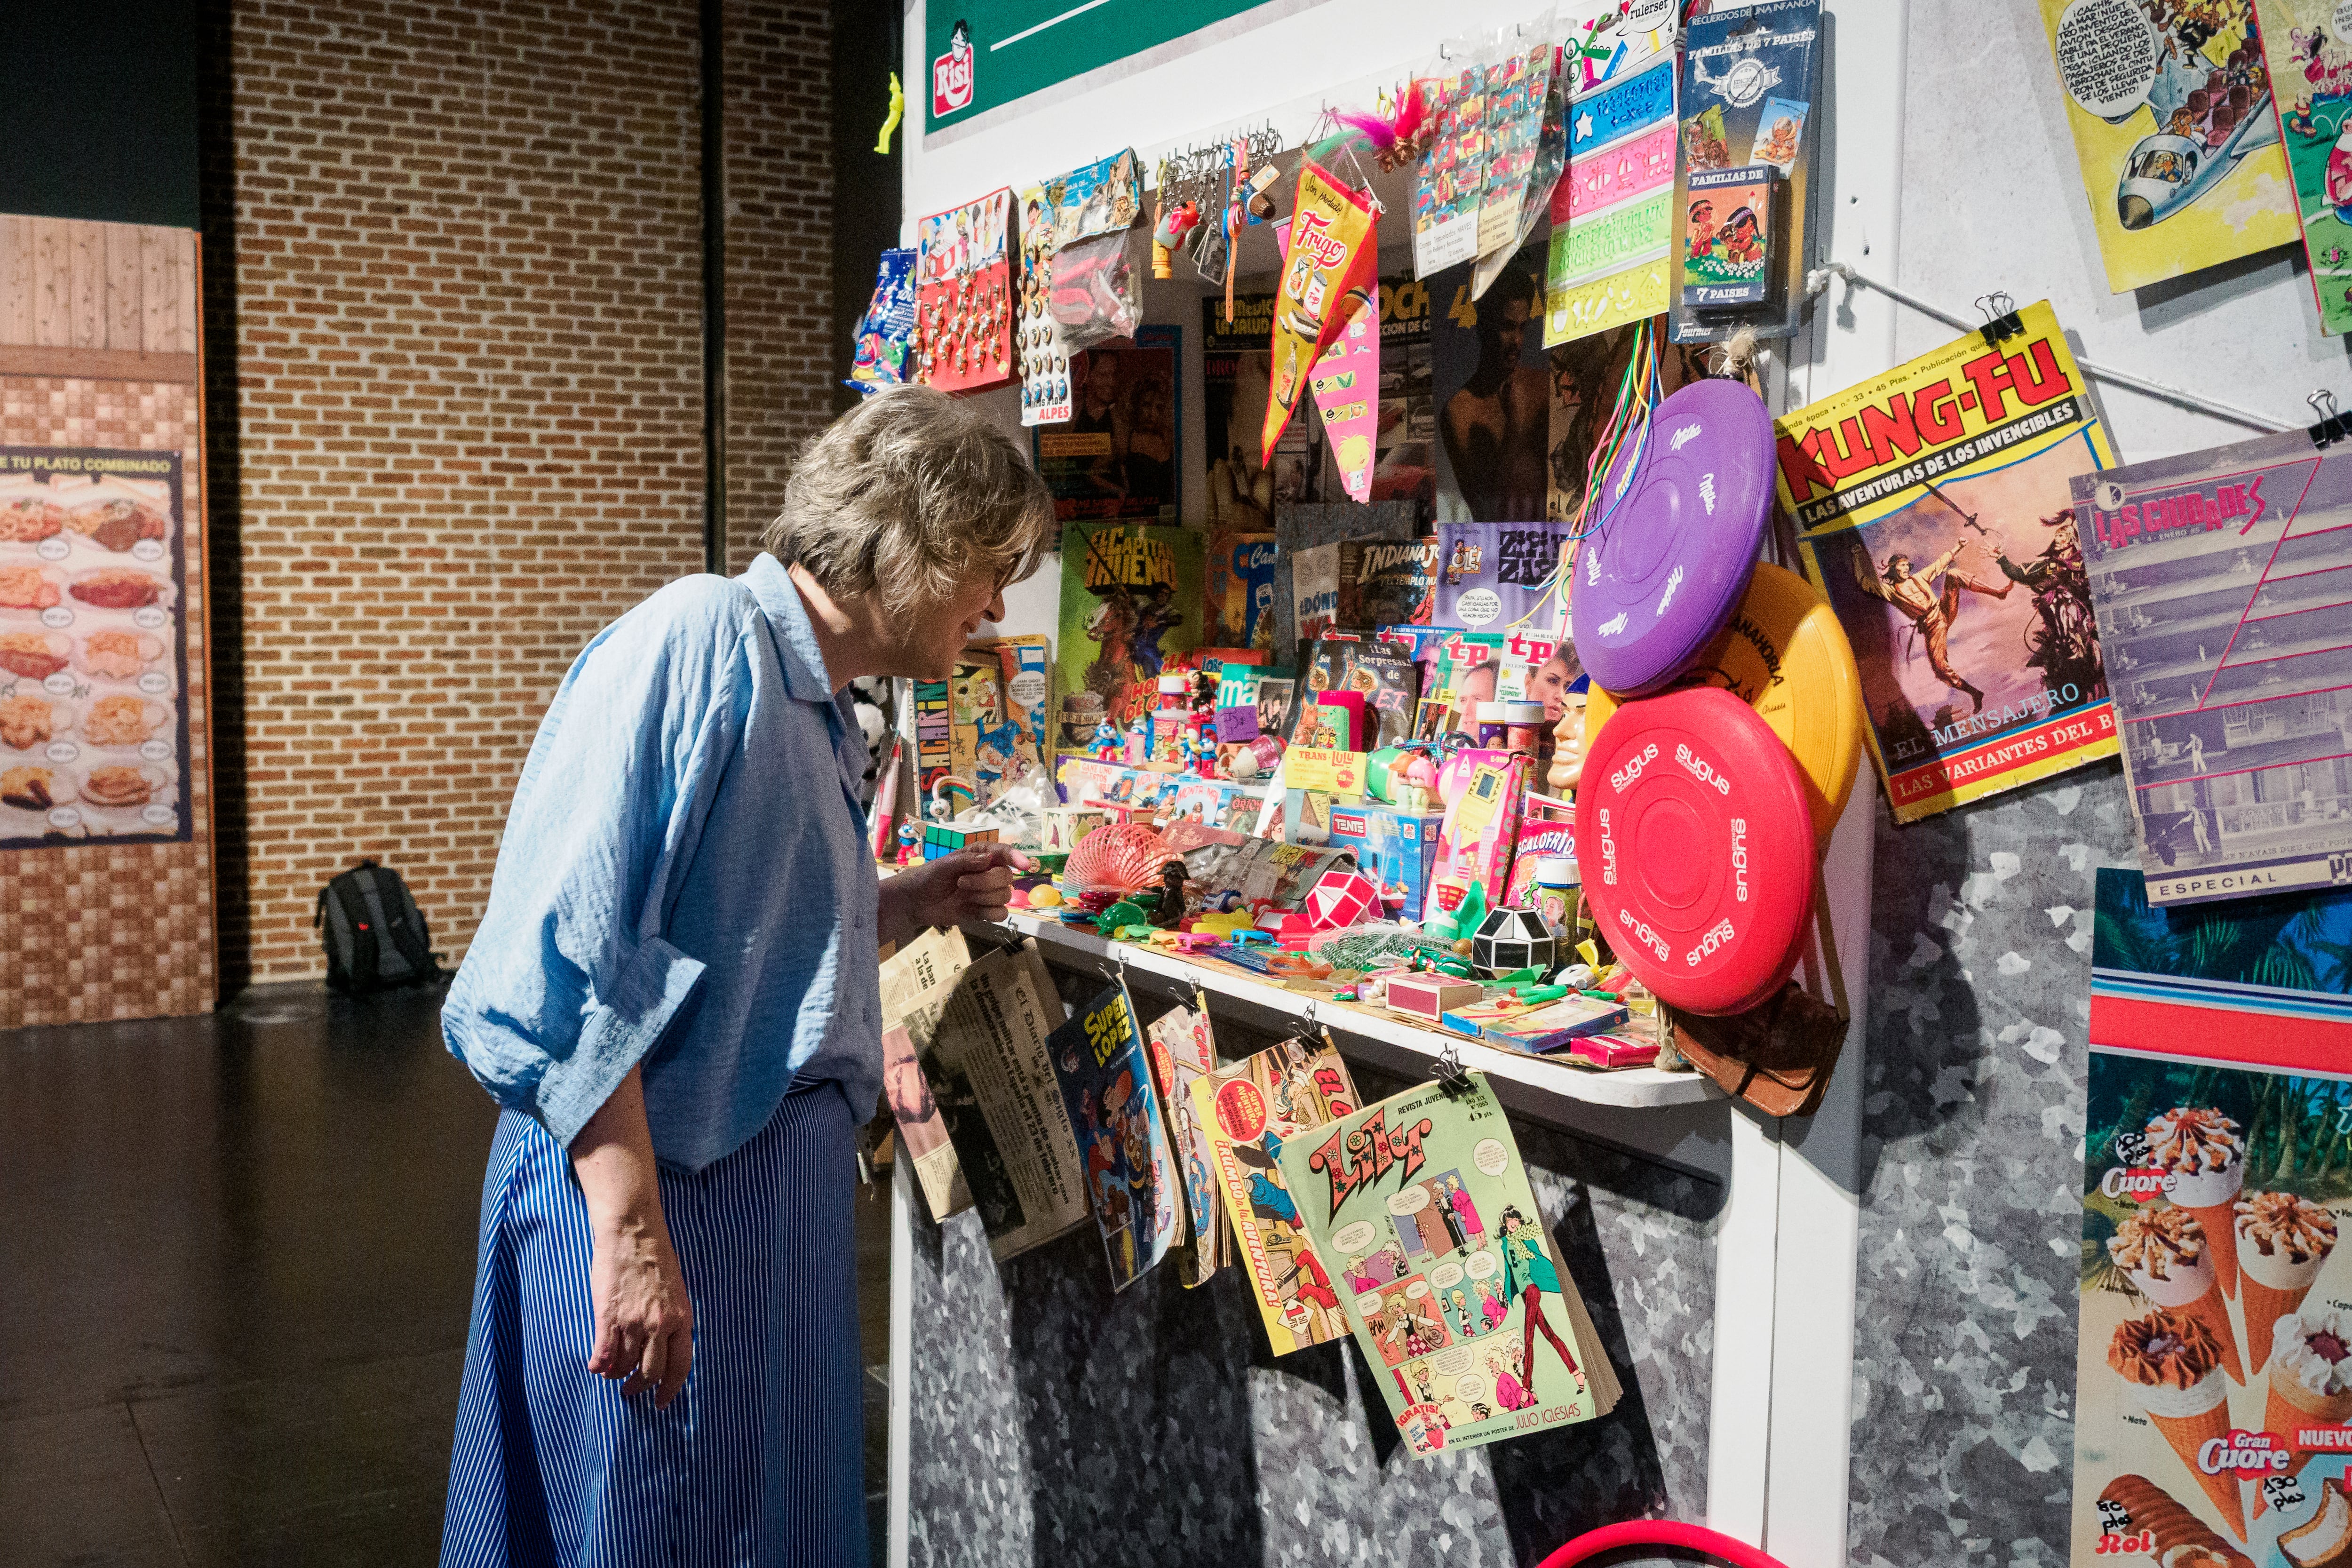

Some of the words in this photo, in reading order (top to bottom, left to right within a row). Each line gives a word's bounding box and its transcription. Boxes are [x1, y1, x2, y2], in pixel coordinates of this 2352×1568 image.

[1630, 1, 1668, 20] rulerset
[1692, 9, 1739, 25] RECUERDOS
[1773, 0, 1815, 12] INFANCIA
[2058, 29, 2077, 40] TRO
[2079, 14, 2118, 33] INVENTO
[2120, 9, 2137, 18] DEL
[1666, 33, 1675, 44] pcs
[1668, 23, 1673, 33] 4
[2063, 21, 2074, 30] LA
[1688, 40, 1743, 60] FAMILIAS
[1773, 31, 1815, 46] PAISES
[2077, 49, 2097, 59] UNA
[2134, 38, 2150, 49] LOS
[935, 56, 970, 96] Risi
[2065, 60, 2117, 81] PASAJEROS
[2070, 68, 2115, 89] ABROCHAN
[2074, 84, 2093, 96] RON
[2095, 80, 2106, 88] DE
[2094, 88, 2109, 97] LOS
[2112, 79, 2138, 90] LLEVA
[1692, 170, 1745, 186] FAMILIAS
[1749, 169, 1763, 180] DE
[1295, 209, 1347, 270] Frigo
[1458, 221, 1472, 232] MAVES
[1697, 288, 1708, 302] 7
[1709, 287, 1749, 299] PAISES
[1806, 407, 1829, 422] época
[1853, 393, 1864, 402] 33
[1876, 383, 1887, 392] 45
[1920, 350, 1967, 373] Publicación
[1039, 406, 1069, 420] ALPES
[1778, 338, 2071, 502] KUNG-FU
[1670, 423, 1702, 451] Milka
[10, 455, 32, 470] TU
[33, 458, 80, 472] PLATO
[84, 458, 172, 473] COMBINADO
[1805, 501, 1835, 523] LAS
[1837, 464, 1925, 510] AVENTURAS
[1924, 453, 1947, 476] DE
[1948, 443, 1976, 466] LOS
[1977, 399, 2077, 456] INVENCIBLES
[1699, 473, 1716, 516] Milka
[2095, 504, 2140, 549] LAS
[2142, 475, 2266, 536] CIUDADES
[1356, 545, 1426, 585] INDIANA
[1586, 547, 1601, 586] Milka
[1656, 565, 1683, 616] Milka
[1598, 612, 1629, 637] Milka
[1445, 637, 1490, 667] tp
[1507, 630, 1555, 665] tp
[1387, 670, 1399, 679] de
[1124, 704, 1144, 723] DE
[1893, 736, 1926, 761] EL
[1931, 682, 2080, 748] MENSAJERO
[1299, 750, 1327, 761] TRANS
[1332, 751, 1354, 766] LULU
[1611, 743, 1658, 789] sugus
[1676, 743, 1731, 795] sugus
[1897, 775, 1934, 798] LAS
[1941, 735, 2049, 781] VARIANTES
[2050, 721, 2093, 748] DEL
[1335, 818, 1364, 834] TENTE
[1600, 808, 1615, 885] sugus
[1735, 818, 1748, 902] sugus
[2160, 873, 2276, 896] ESPECIAL
[1620, 908, 1669, 962] sugus
[1686, 923, 1735, 967] sugus
[916, 964, 927, 976] la
[921, 951, 932, 965] La
[983, 988, 1004, 1020] golpe
[973, 989, 1006, 1055] democracia
[1084, 994, 1128, 1048] SUPER
[996, 1019, 1018, 1058] militar
[1094, 1015, 1132, 1067] LOPEZ
[1000, 1054, 1011, 1069] en
[1011, 1056, 1029, 1084] está
[1004, 1068, 1027, 1109] España
[1314, 1067, 1344, 1097] EL
[1021, 1108, 1033, 1122] el
[1023, 1091, 1045, 1127] punto
[1233, 1083, 1262, 1130] AVENTURAS
[1246, 1089, 1265, 1118] SUPER
[1398, 1100, 1422, 1115] REVISTA
[1468, 1110, 1482, 1122] 45
[1025, 1120, 1039, 1137] 23
[1038, 1125, 1051, 1142] de
[1032, 1136, 1045, 1152] de
[1037, 1151, 1061, 1195] febrero
[1043, 1141, 1065, 1181] acabar
[1310, 1106, 1432, 1228] Lily
[1057, 1182, 1072, 1205] con
[2102, 1167, 2177, 1199] Cuore
[1215, 1140, 1245, 1199] ¡RUMBO
[1241, 1220, 1282, 1308] AVENTURA!
[1368, 1319, 1386, 1337] BAM
[1396, 1402, 1438, 1427] ¡GRATIS!
[1462, 1432, 1483, 1441] INTERIOR
[1491, 1427, 1508, 1435] POSTER
[1515, 1411, 1539, 1430] JULIO
[1542, 1402, 1581, 1424] IGLESIAS
[2234, 1433, 2271, 1449] Gran
[2198, 1437, 2290, 1476] Cuore
[2263, 1476, 2297, 1495] 130
[2096, 1530, 2152, 1554] Rol
